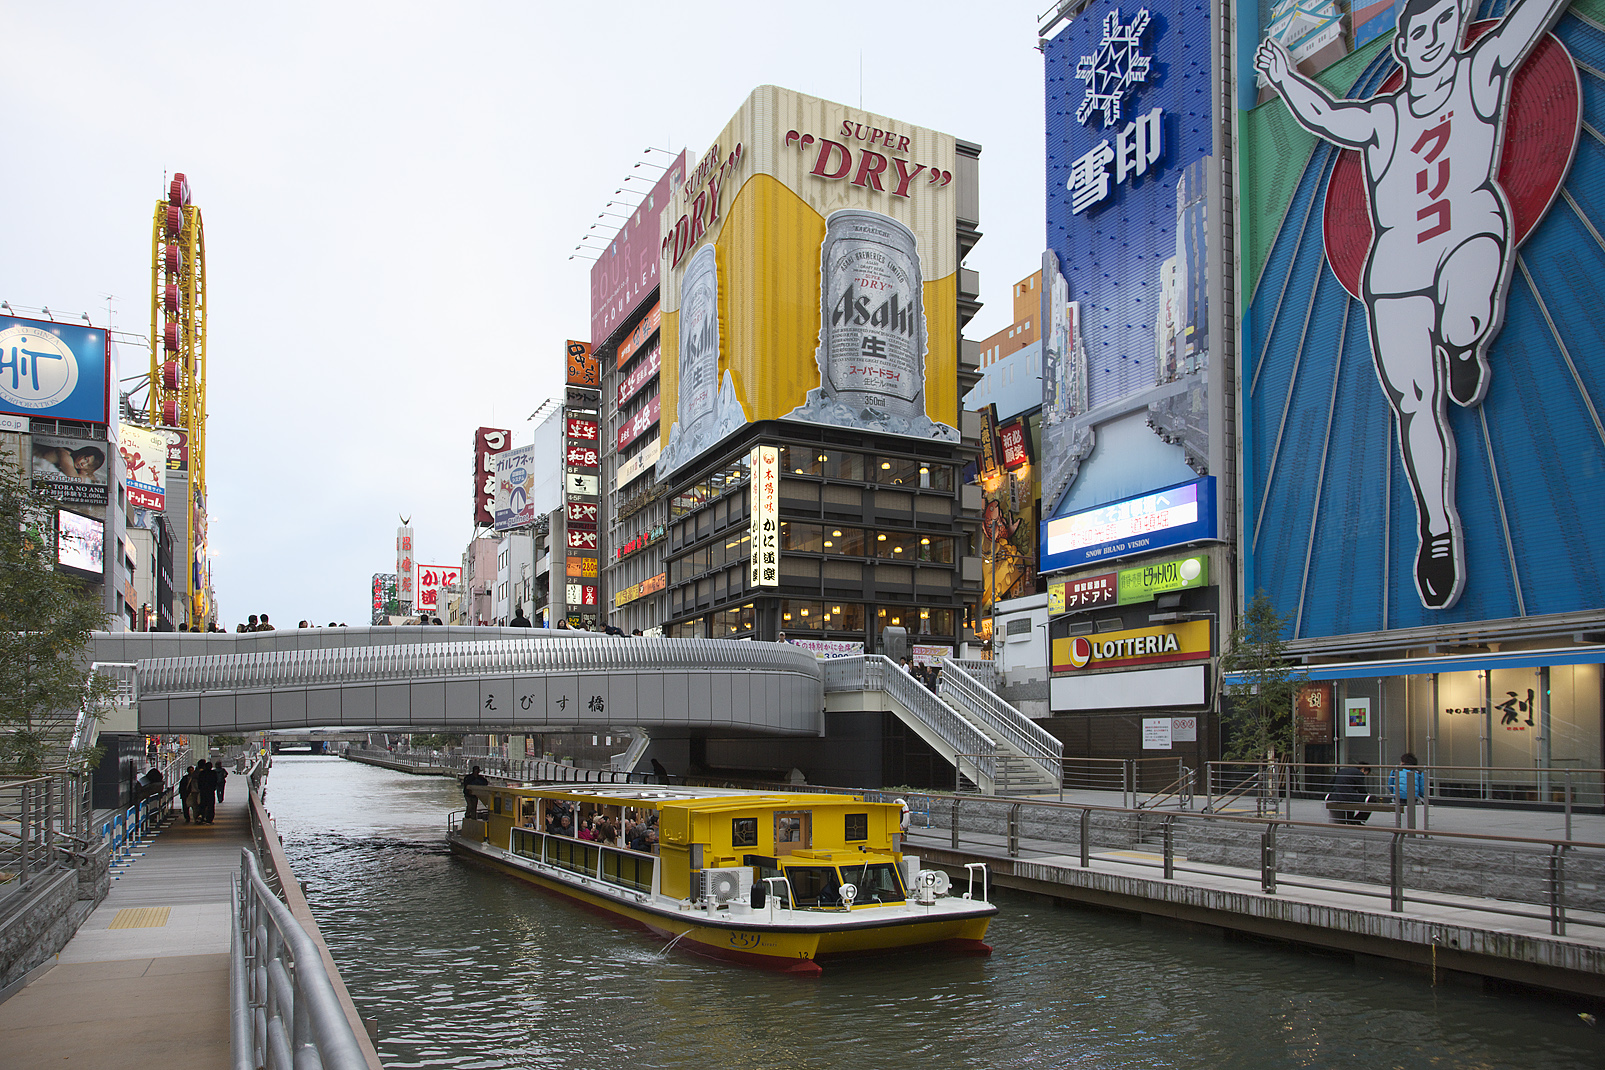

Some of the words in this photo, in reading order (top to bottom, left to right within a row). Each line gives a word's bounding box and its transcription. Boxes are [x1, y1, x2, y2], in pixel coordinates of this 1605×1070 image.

[840, 119, 911, 153] SUPER
[684, 143, 719, 203] SUPER
[1066, 107, 1162, 215] 雪印
[1410, 110, 1454, 245] グリコ
[855, 251, 886, 264] BREWERIES
[887, 261, 905, 284] LIMITED
[832, 284, 914, 338] Asahi
[861, 335, 887, 359] 生
[849, 365, 900, 381] スーパードライ
[151, 437, 162, 446] dip
[567, 450, 597, 464] 和民
[128, 491, 162, 508] ドットコム
[763, 468, 774, 513] 本場の味
[568, 505, 597, 520] はや
[568, 531, 597, 548] はや
[763, 518, 775, 581] かに道楽
[1085, 549, 1102, 558] SNOW
[1103, 544, 1125, 555] BRAND
[1127, 538, 1150, 549] VISION
[421, 570, 457, 587] かに
[1143, 562, 1178, 587] ピタットハウス
[1069, 588, 1113, 606] アドアド
[1093, 633, 1180, 659] LOTTERIA
[484, 694, 604, 713] えびす橋
[1495, 688, 1535, 727] 刻
